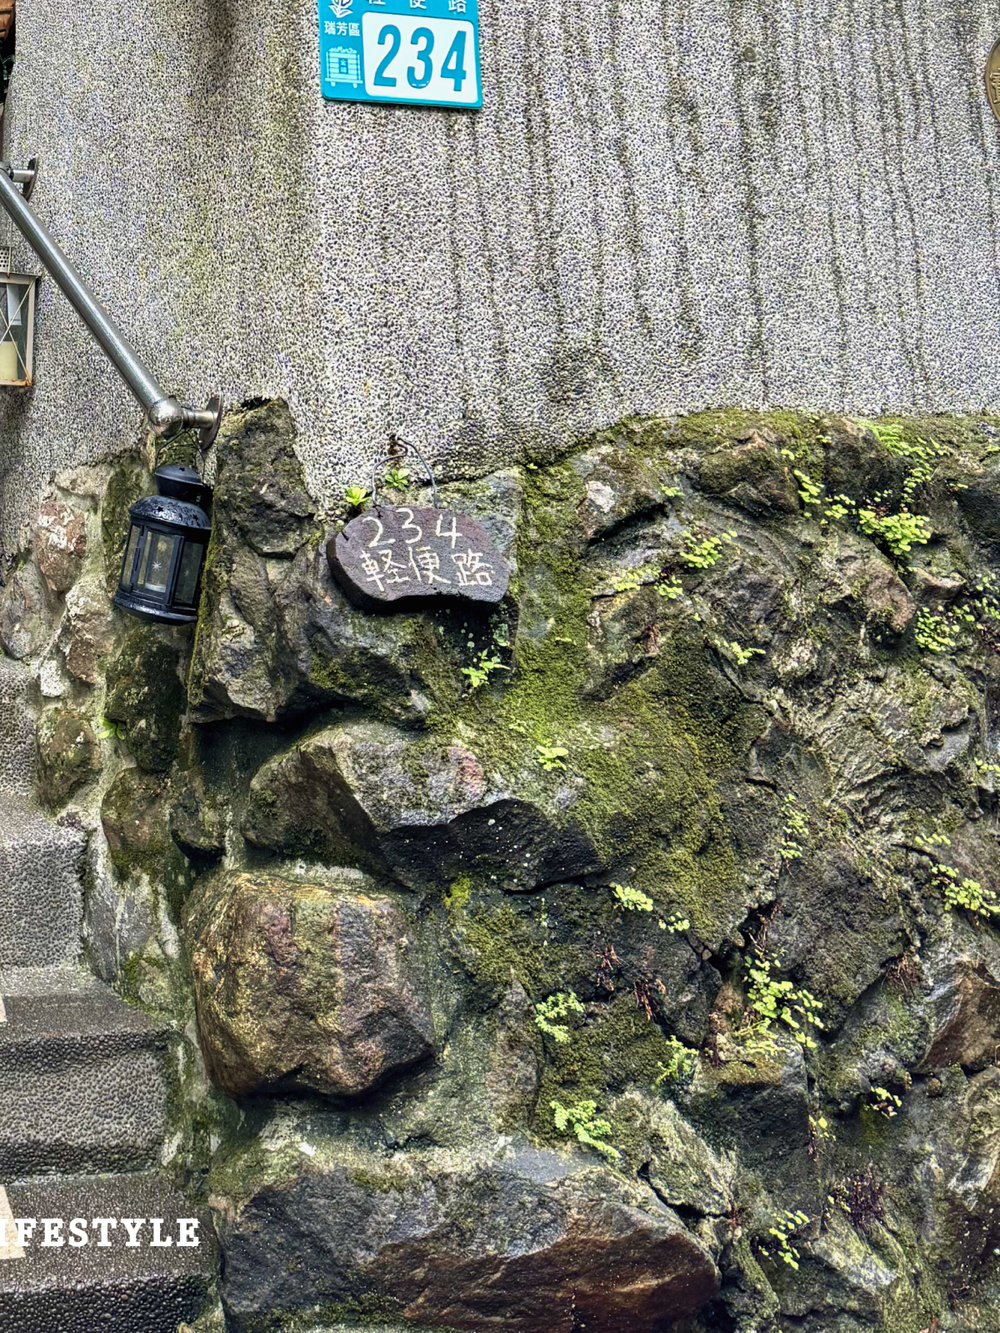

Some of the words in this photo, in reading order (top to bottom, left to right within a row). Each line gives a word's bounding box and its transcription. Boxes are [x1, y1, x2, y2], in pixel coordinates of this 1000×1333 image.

[324, 20, 360, 37] 瑞芳區
[373, 24, 467, 92] 234
[362, 508, 463, 549] 234
